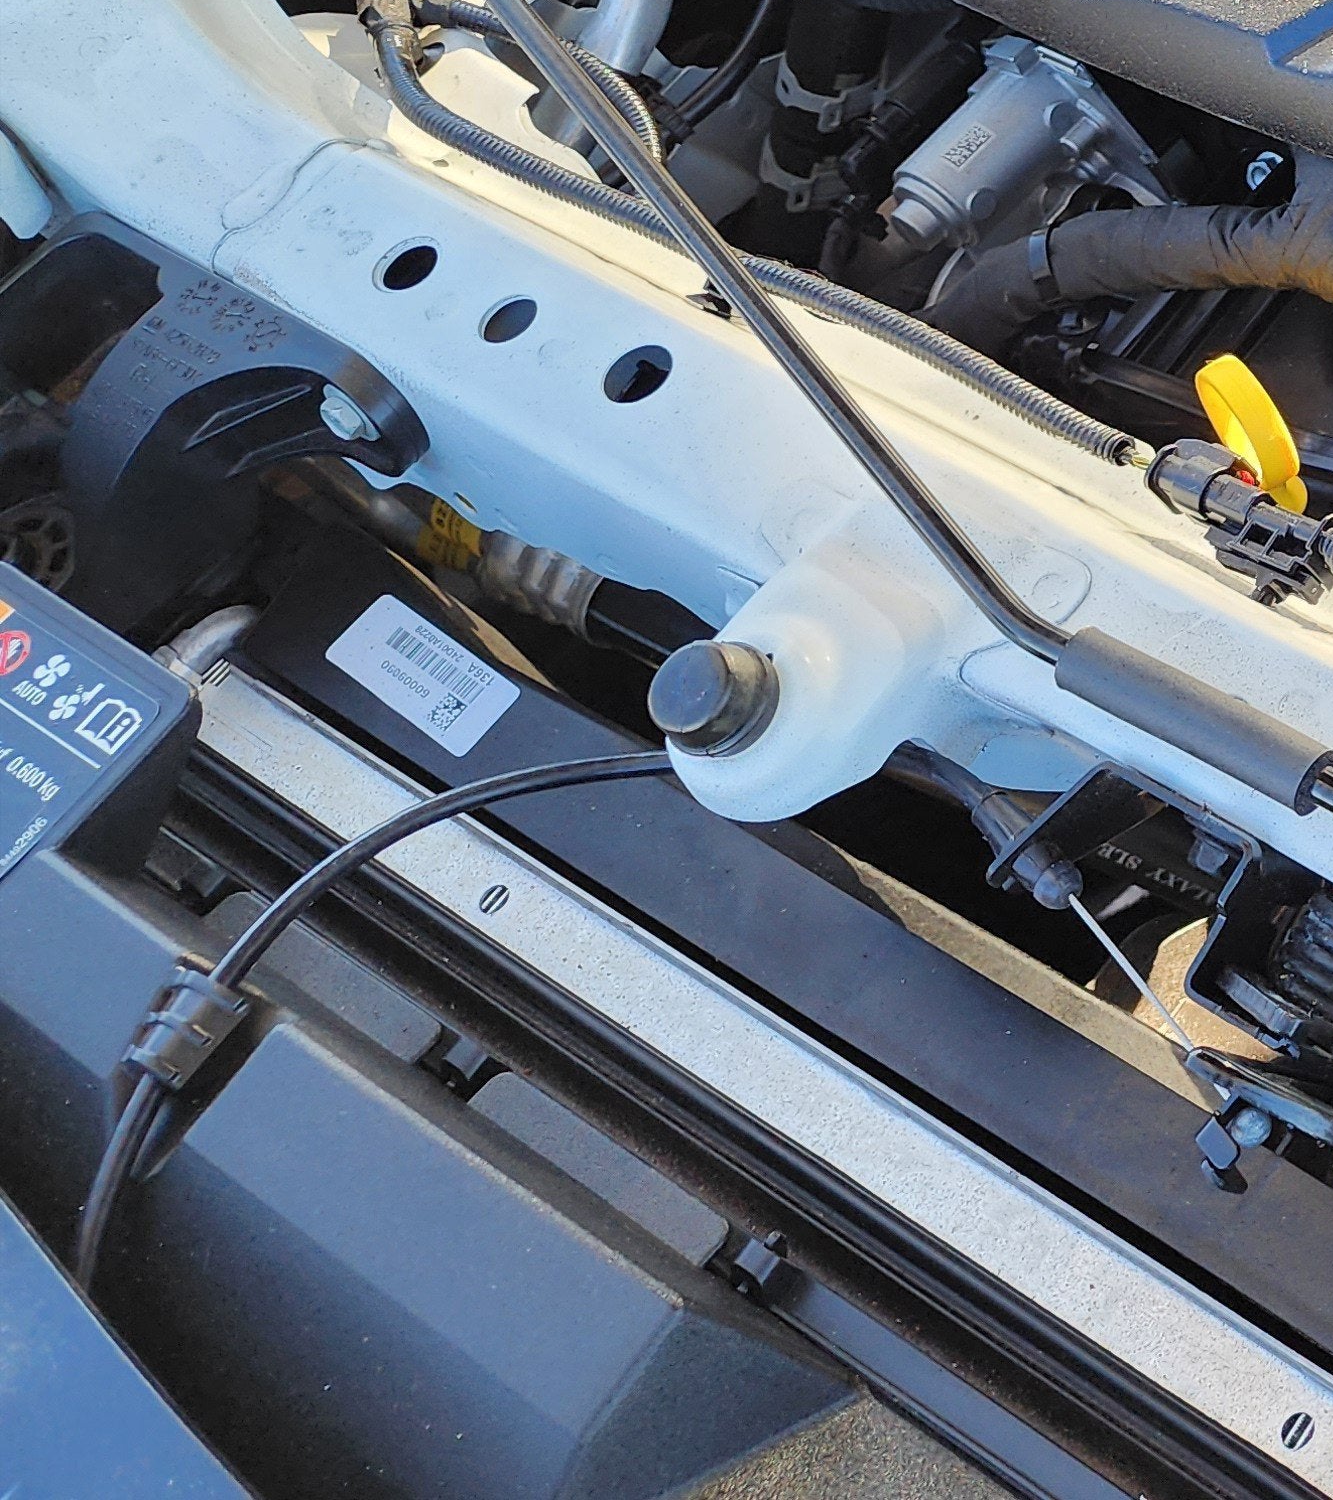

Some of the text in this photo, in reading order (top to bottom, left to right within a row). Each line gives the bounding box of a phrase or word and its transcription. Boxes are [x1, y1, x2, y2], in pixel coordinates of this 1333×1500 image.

[380, 659, 431, 699] 60009090
[466, 661, 496, 688] 136A
[11, 680, 48, 706] AUTO
[37, 776, 62, 802] kg
